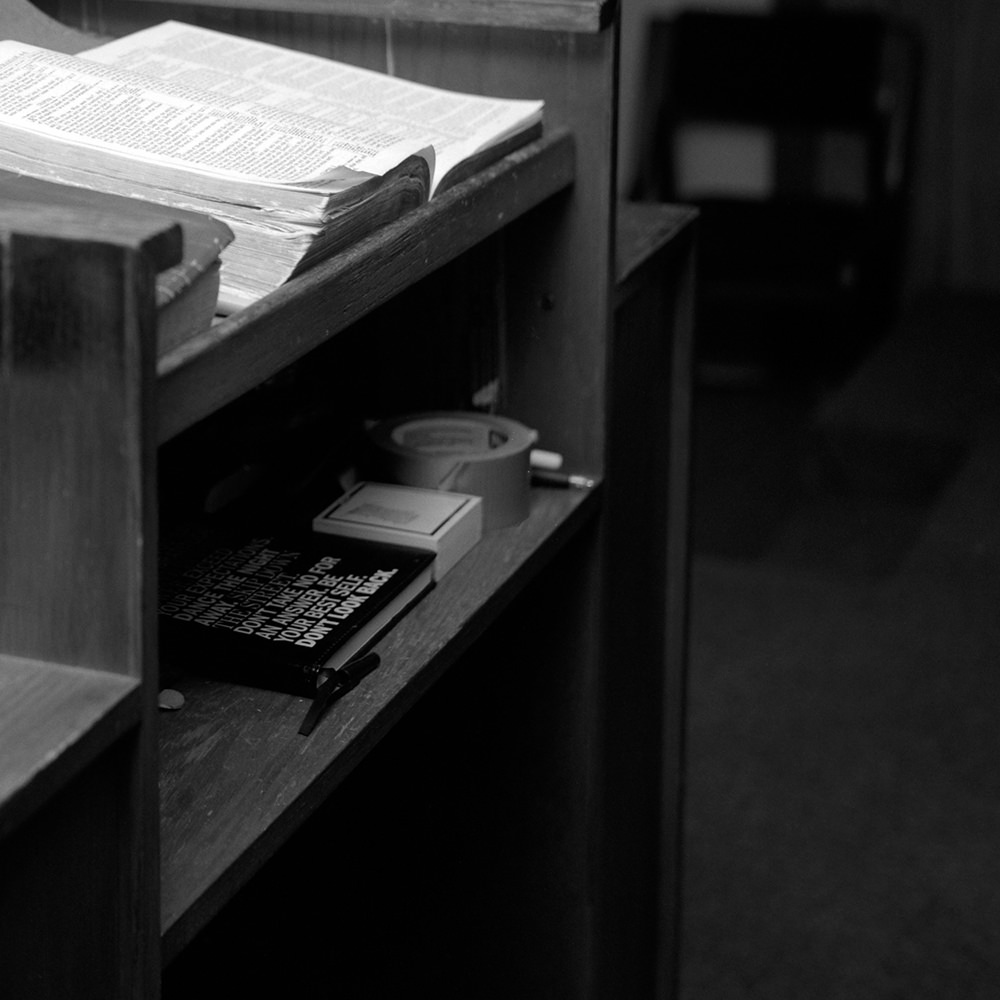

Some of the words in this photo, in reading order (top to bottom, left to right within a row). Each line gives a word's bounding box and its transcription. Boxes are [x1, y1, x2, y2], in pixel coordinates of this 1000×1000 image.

[172, 593, 225, 621] DANCE
[211, 574, 248, 591] THE
[236, 548, 281, 575] NIGHT
[194, 600, 238, 627] AWAY.
[225, 579, 265, 601] SKIP
[211, 610, 252, 630] THE
[240, 573, 300, 611] STREET.
[233, 608, 277, 635] DON'T
[265, 588, 303, 608] TAKE
[291, 574, 319, 588] NO
[308, 556, 341, 575] FOR
[255, 624, 283, 640] AN
[271, 588, 330, 626] ANSWER.
[317, 574, 344, 587] BE
[273, 618, 316, 642] YOUR
[303, 596, 341, 619] BEST
[330, 574, 368, 597] SELF.
[294, 618, 340, 648] DON'T
[327, 594, 369, 620] LOOK
[355, 568, 399, 595] BACK.
